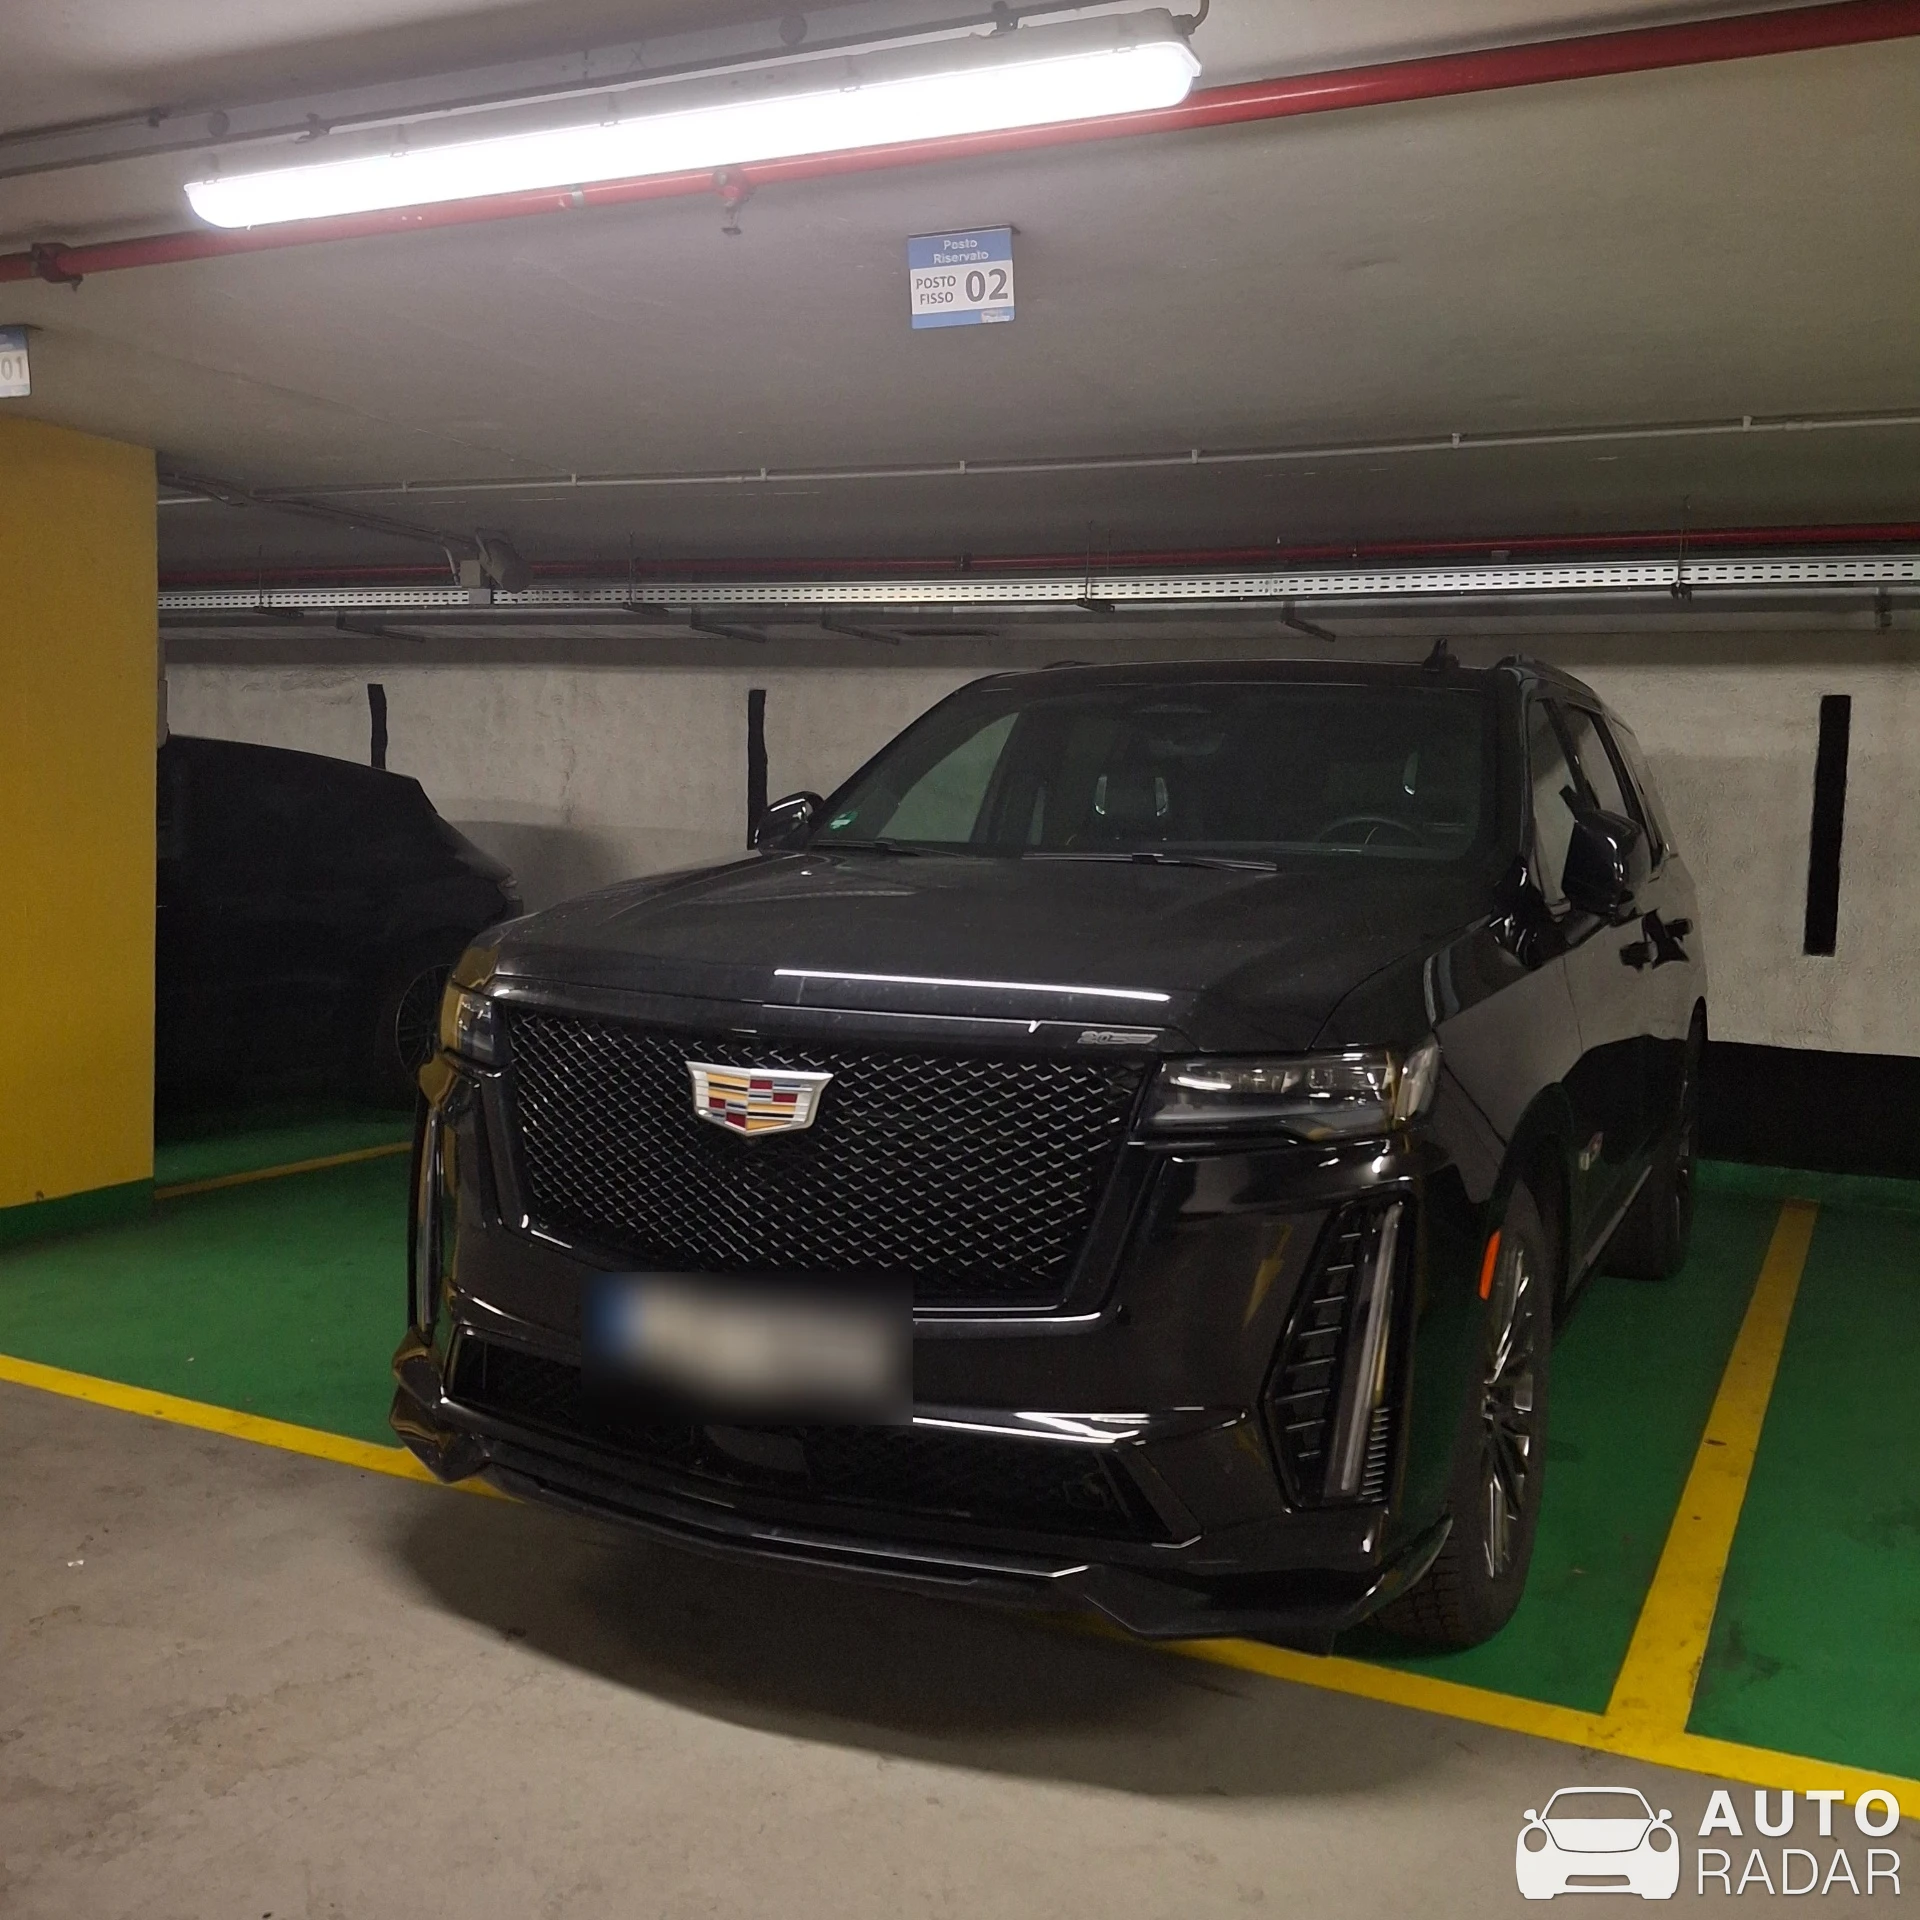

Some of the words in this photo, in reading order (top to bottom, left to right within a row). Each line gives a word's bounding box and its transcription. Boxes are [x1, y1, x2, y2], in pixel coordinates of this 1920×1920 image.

[943, 239, 978, 250] Posto
[934, 250, 989, 264] Riservato
[916, 275, 956, 289] POSTO
[966, 268, 1008, 302] 02
[920, 291, 954, 305] FISSO
[1, 355, 22, 381] 01
